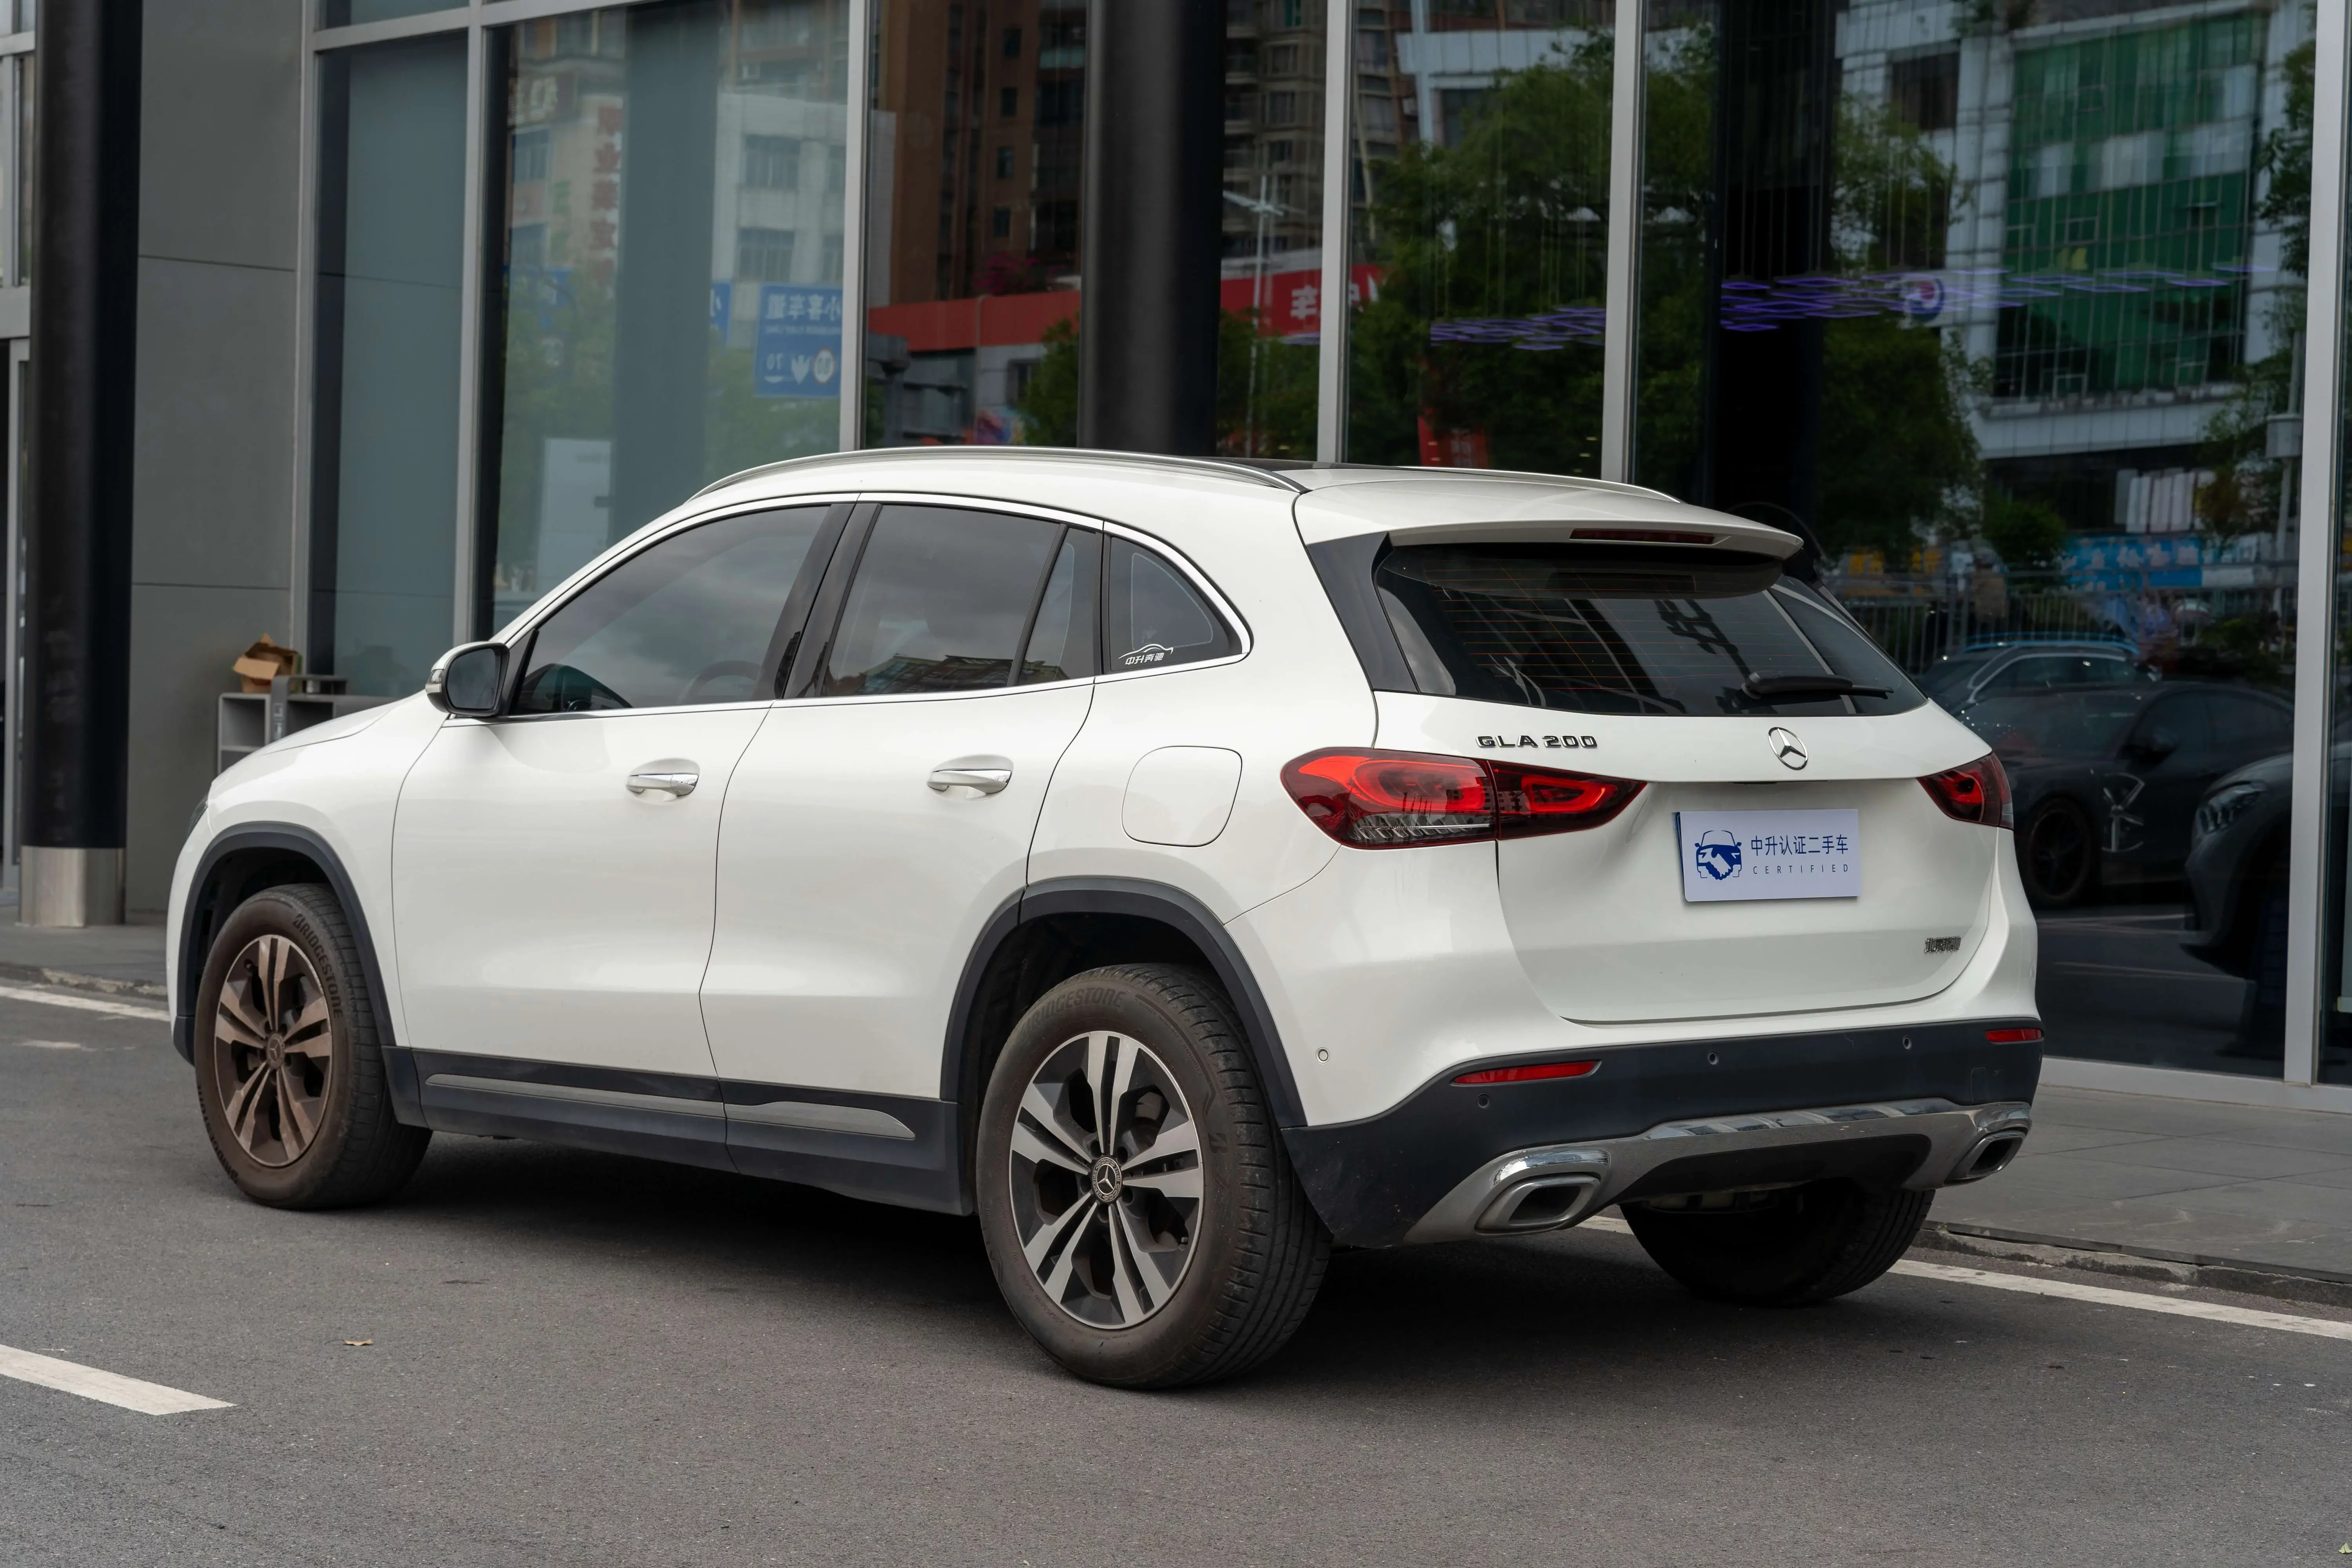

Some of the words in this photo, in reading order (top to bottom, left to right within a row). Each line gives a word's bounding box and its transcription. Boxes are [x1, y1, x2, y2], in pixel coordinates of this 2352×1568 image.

[1125, 652, 1165, 665] 中升奔驰
[1475, 735, 1539, 748] GLA
[1543, 735, 1598, 748] 200
[1750, 834, 1849, 856] 中升认证二手车
[1753, 864, 1849, 875] CERTIFIED
[1093, 1170, 1103, 1198] MERCEDES
